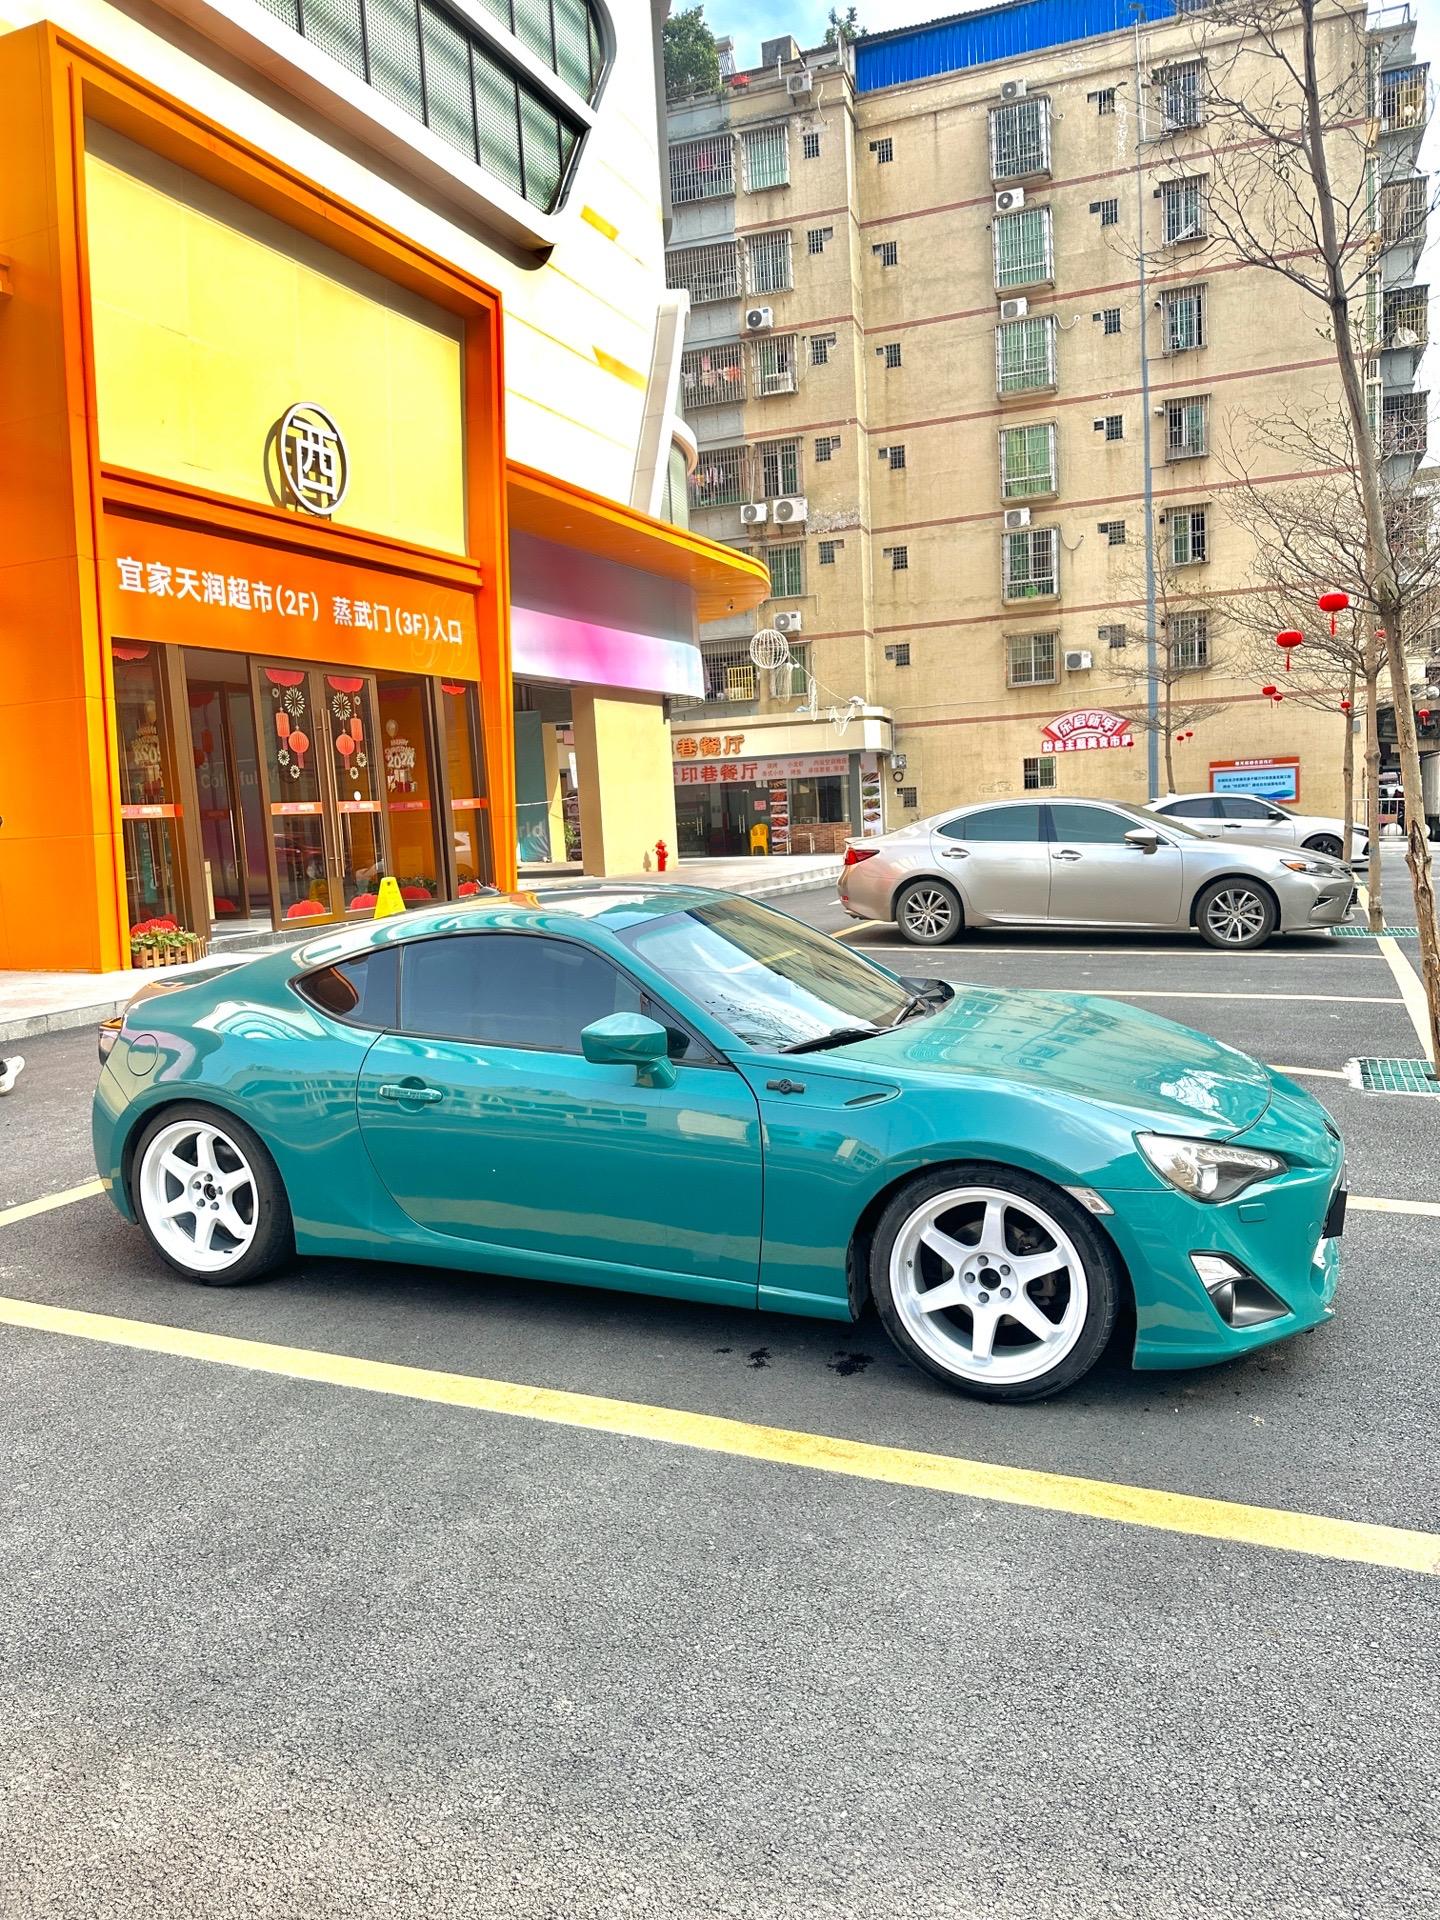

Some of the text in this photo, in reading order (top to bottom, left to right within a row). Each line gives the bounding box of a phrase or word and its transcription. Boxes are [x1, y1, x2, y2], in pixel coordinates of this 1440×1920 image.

[116, 556, 463, 645] 宜家天润超市(2F) 蒸武门(3F)入口
[1058, 713, 1118, 738] 乐启新年
[672, 734, 744, 758] 巷餐厅
[387, 752, 415, 769] 2024
